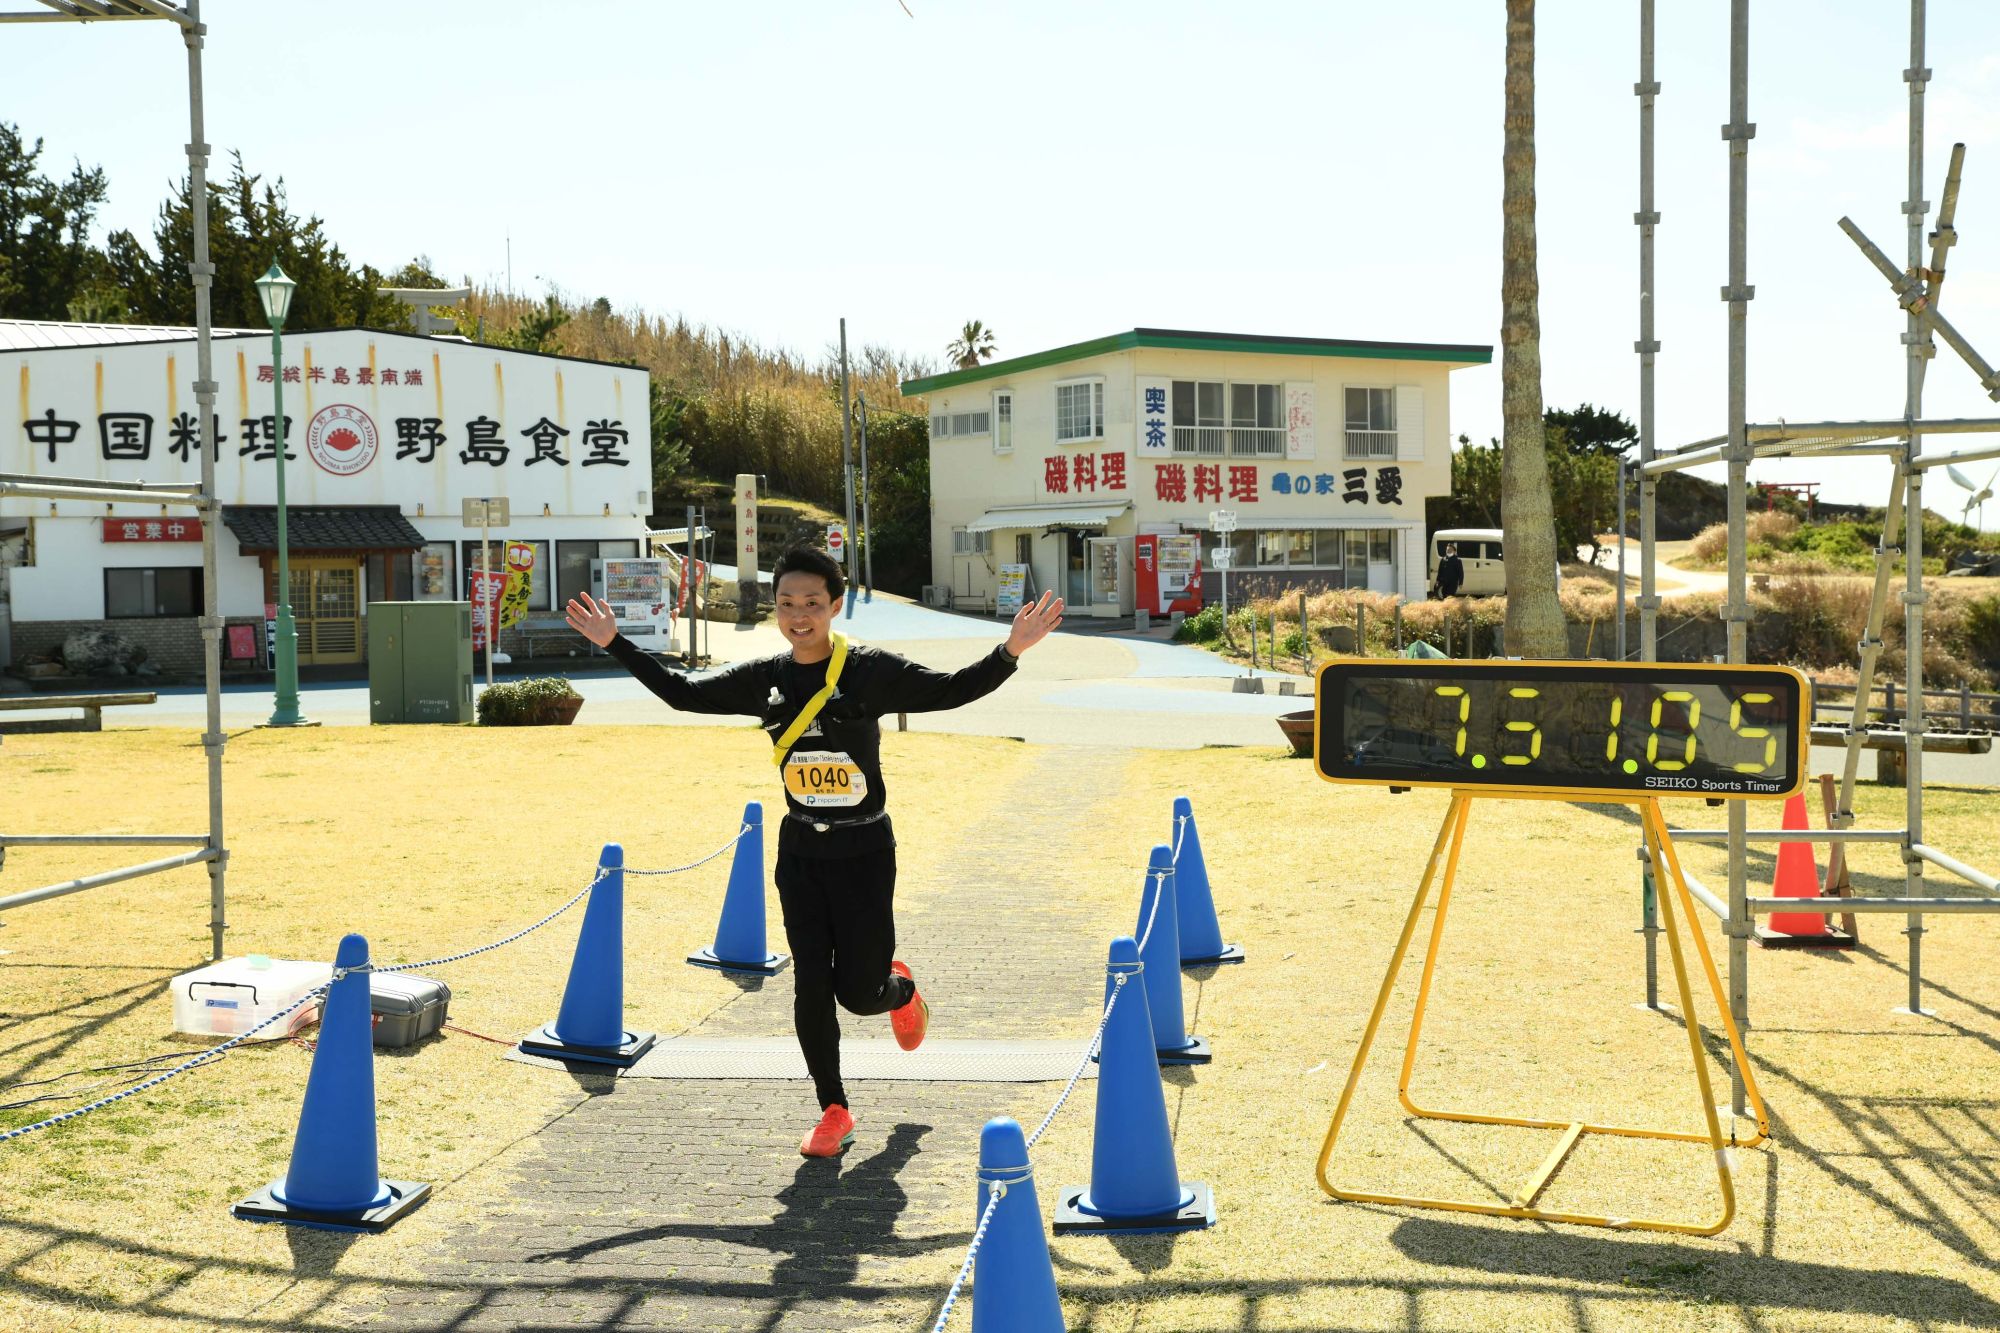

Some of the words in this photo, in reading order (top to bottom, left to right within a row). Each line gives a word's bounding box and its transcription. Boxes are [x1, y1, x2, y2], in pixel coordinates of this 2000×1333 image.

[256, 365, 424, 386] 房総半島最南端
[1145, 387, 1167, 448] 喫茶
[22, 408, 297, 463] 中国料理
[395, 415, 630, 468] 野島食堂
[318, 451, 340, 470] NOJIMA
[342, 451, 370, 471] SHOKUDO
[1044, 452, 1126, 494] 磯料理
[1155, 463, 1259, 503] 磯料理
[1271, 472, 1335, 495] 亀の家
[1342, 466, 1403, 506] 三愛
[121, 522, 185, 540] 営業中
[796, 767, 849, 788] 1040
[1645, 776, 1698, 789] SEIKO
[1701, 779, 1742, 791] Sports
[1745, 780, 1781, 791] Timer
